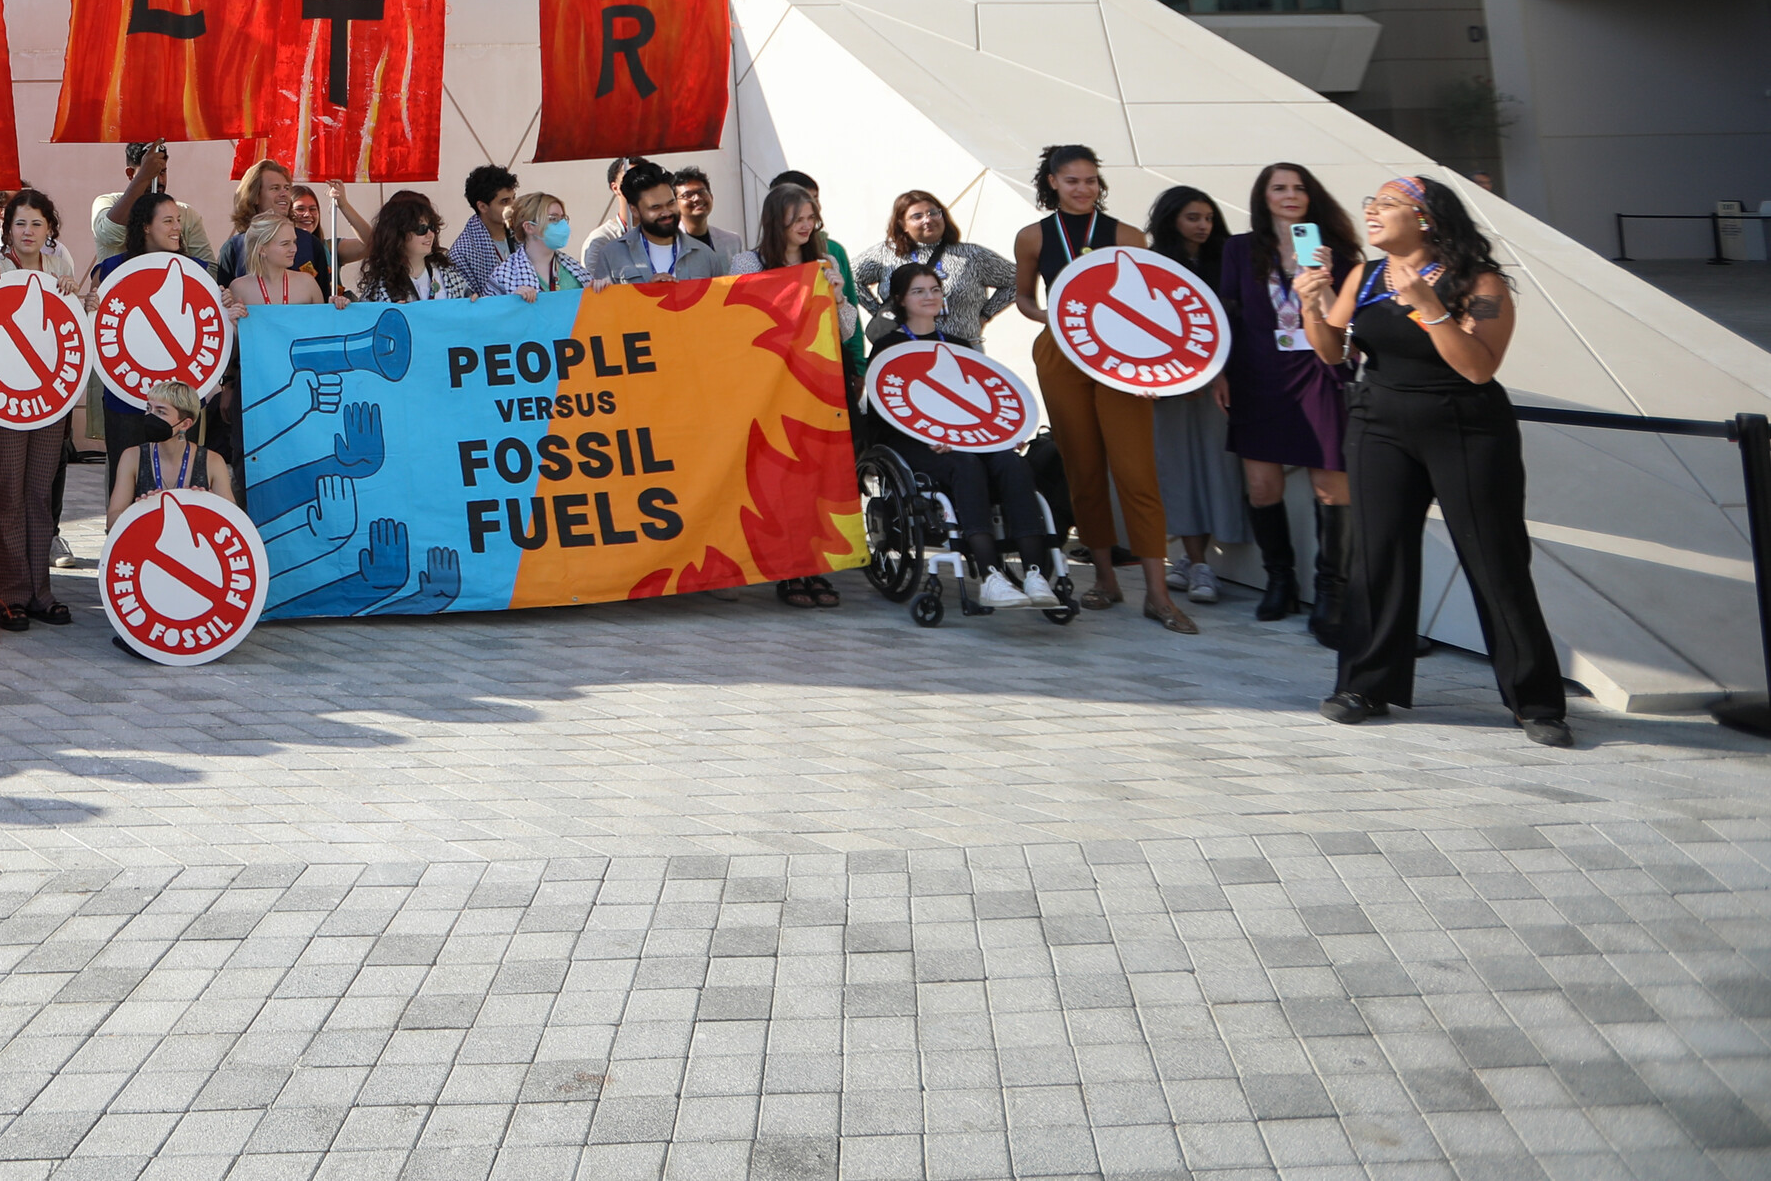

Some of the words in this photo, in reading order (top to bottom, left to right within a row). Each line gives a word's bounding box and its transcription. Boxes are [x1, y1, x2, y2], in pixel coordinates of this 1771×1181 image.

[52, 321, 81, 399] FUELS
[100, 297, 126, 358] #END
[188, 306, 220, 382] FUELS
[448, 331, 657, 388] PEOPLE
[1064, 299, 1100, 357] #END
[1101, 355, 1195, 382] FOSSIL
[1171, 286, 1214, 358] FUELS
[494, 390, 616, 423] VERSUS
[883, 374, 913, 417] #END
[913, 418, 1001, 444] FOSSIL
[984, 376, 1021, 431] FUELS
[457, 426, 675, 487] FOSSIL
[466, 487, 684, 553] FUELS
[113, 560, 147, 627] #END
[148, 615, 234, 649] FOSSIL
[214, 526, 252, 610] FUELS
